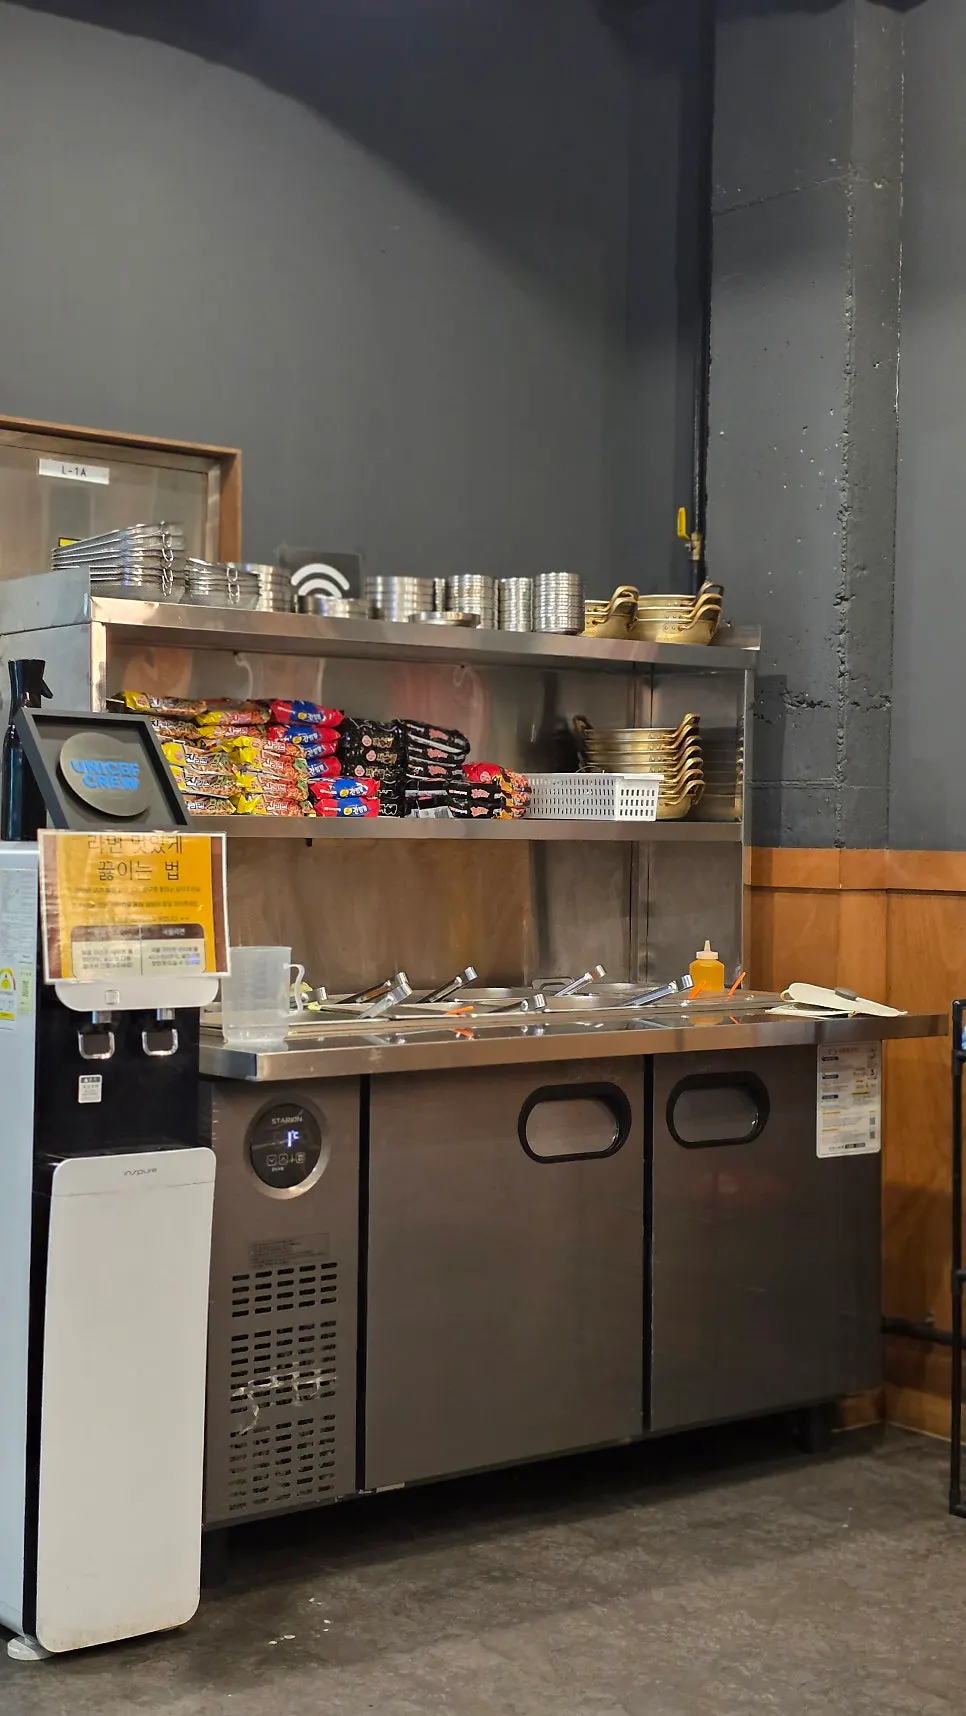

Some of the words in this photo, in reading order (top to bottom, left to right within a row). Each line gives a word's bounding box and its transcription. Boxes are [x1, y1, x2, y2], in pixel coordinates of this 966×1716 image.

[61, 465, 87, 477] L-1A
[70, 760, 138, 777] UNICEF
[83, 773, 138, 791] CREW
[87, 835, 123, 854] 라면
[130, 835, 183, 854] 맛있게
[98, 860, 152, 881] 끓이는
[164, 860, 179, 881] 법
[271, 1116, 303, 1125] STARION
[123, 1167, 158, 1176] inspure
